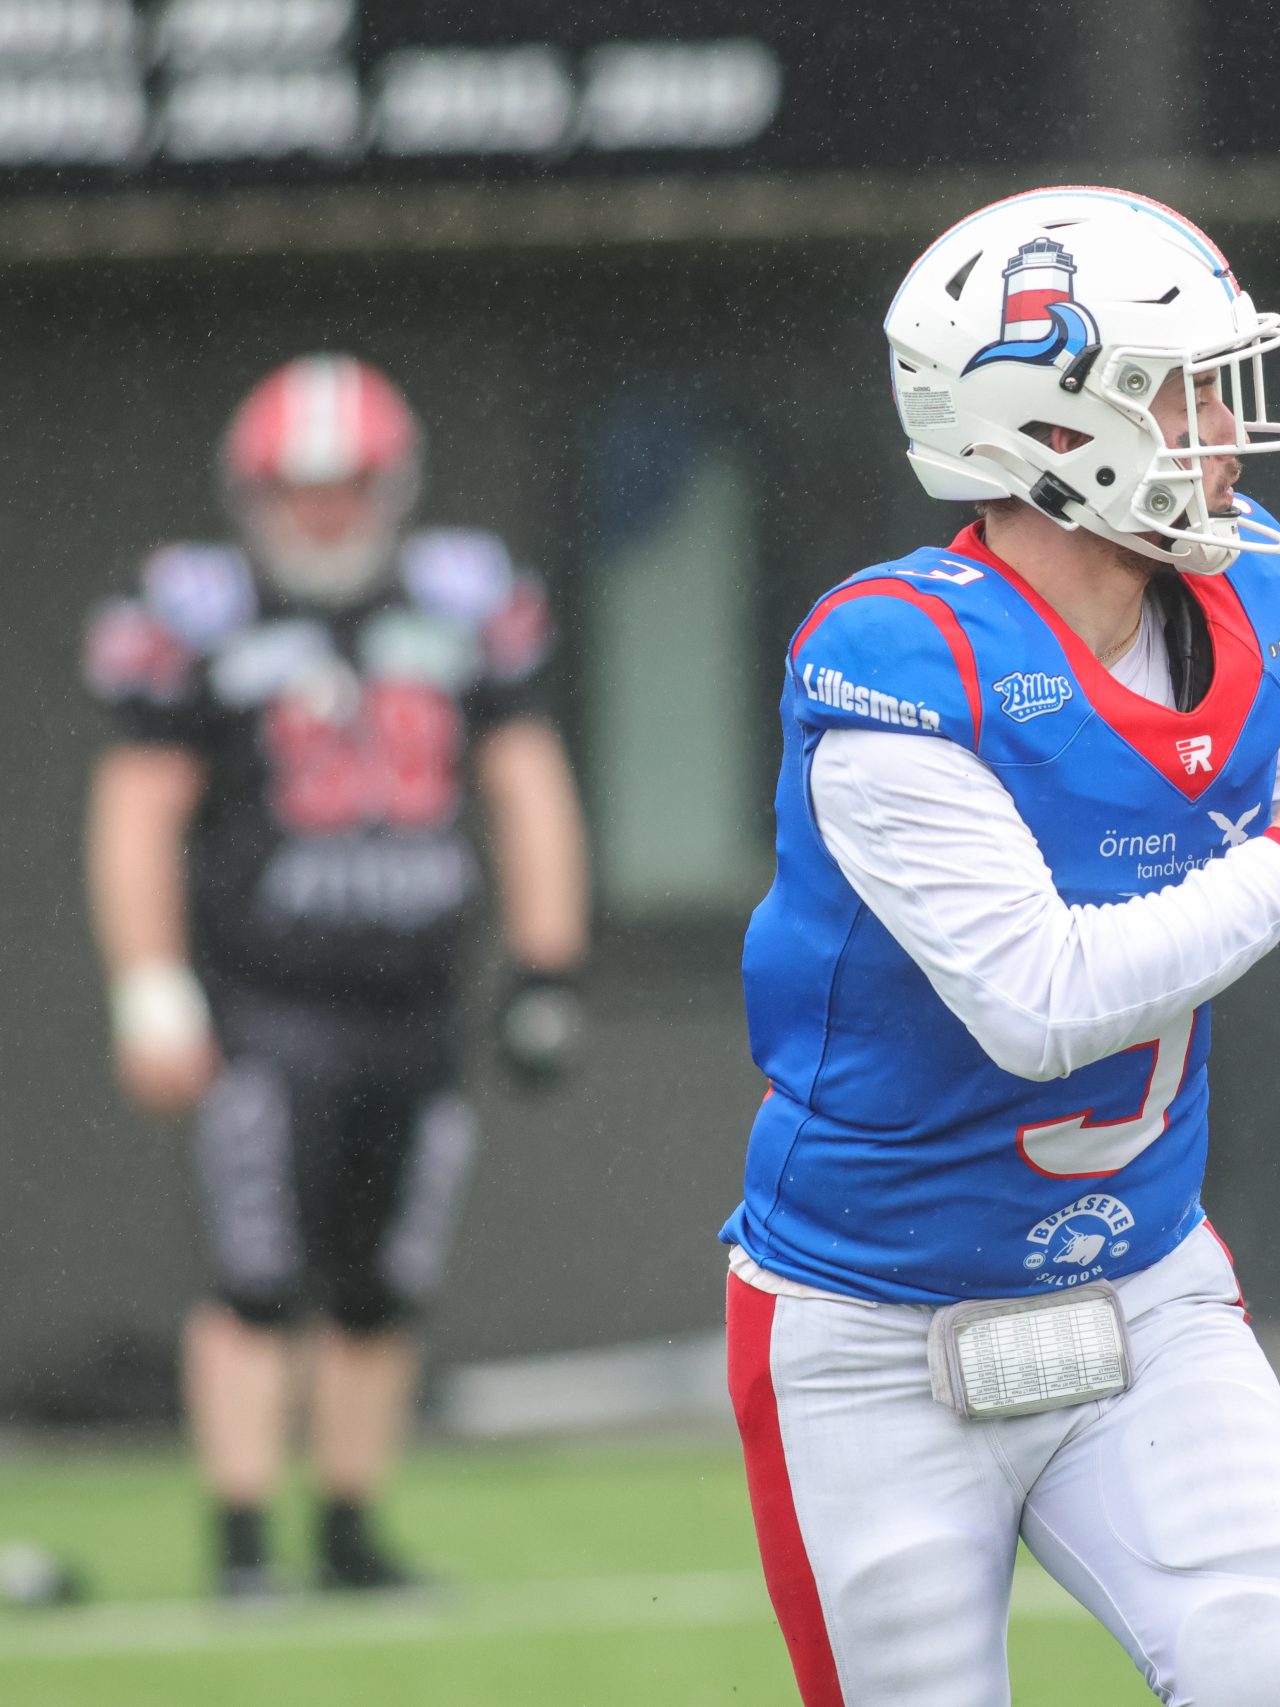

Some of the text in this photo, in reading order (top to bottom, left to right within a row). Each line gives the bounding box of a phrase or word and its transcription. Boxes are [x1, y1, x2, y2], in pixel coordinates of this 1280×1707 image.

[1100, 830, 1176, 857] örnen
[1032, 1196, 1130, 1240] BULLSEYE
[1036, 1264, 1104, 1287] SALOON
